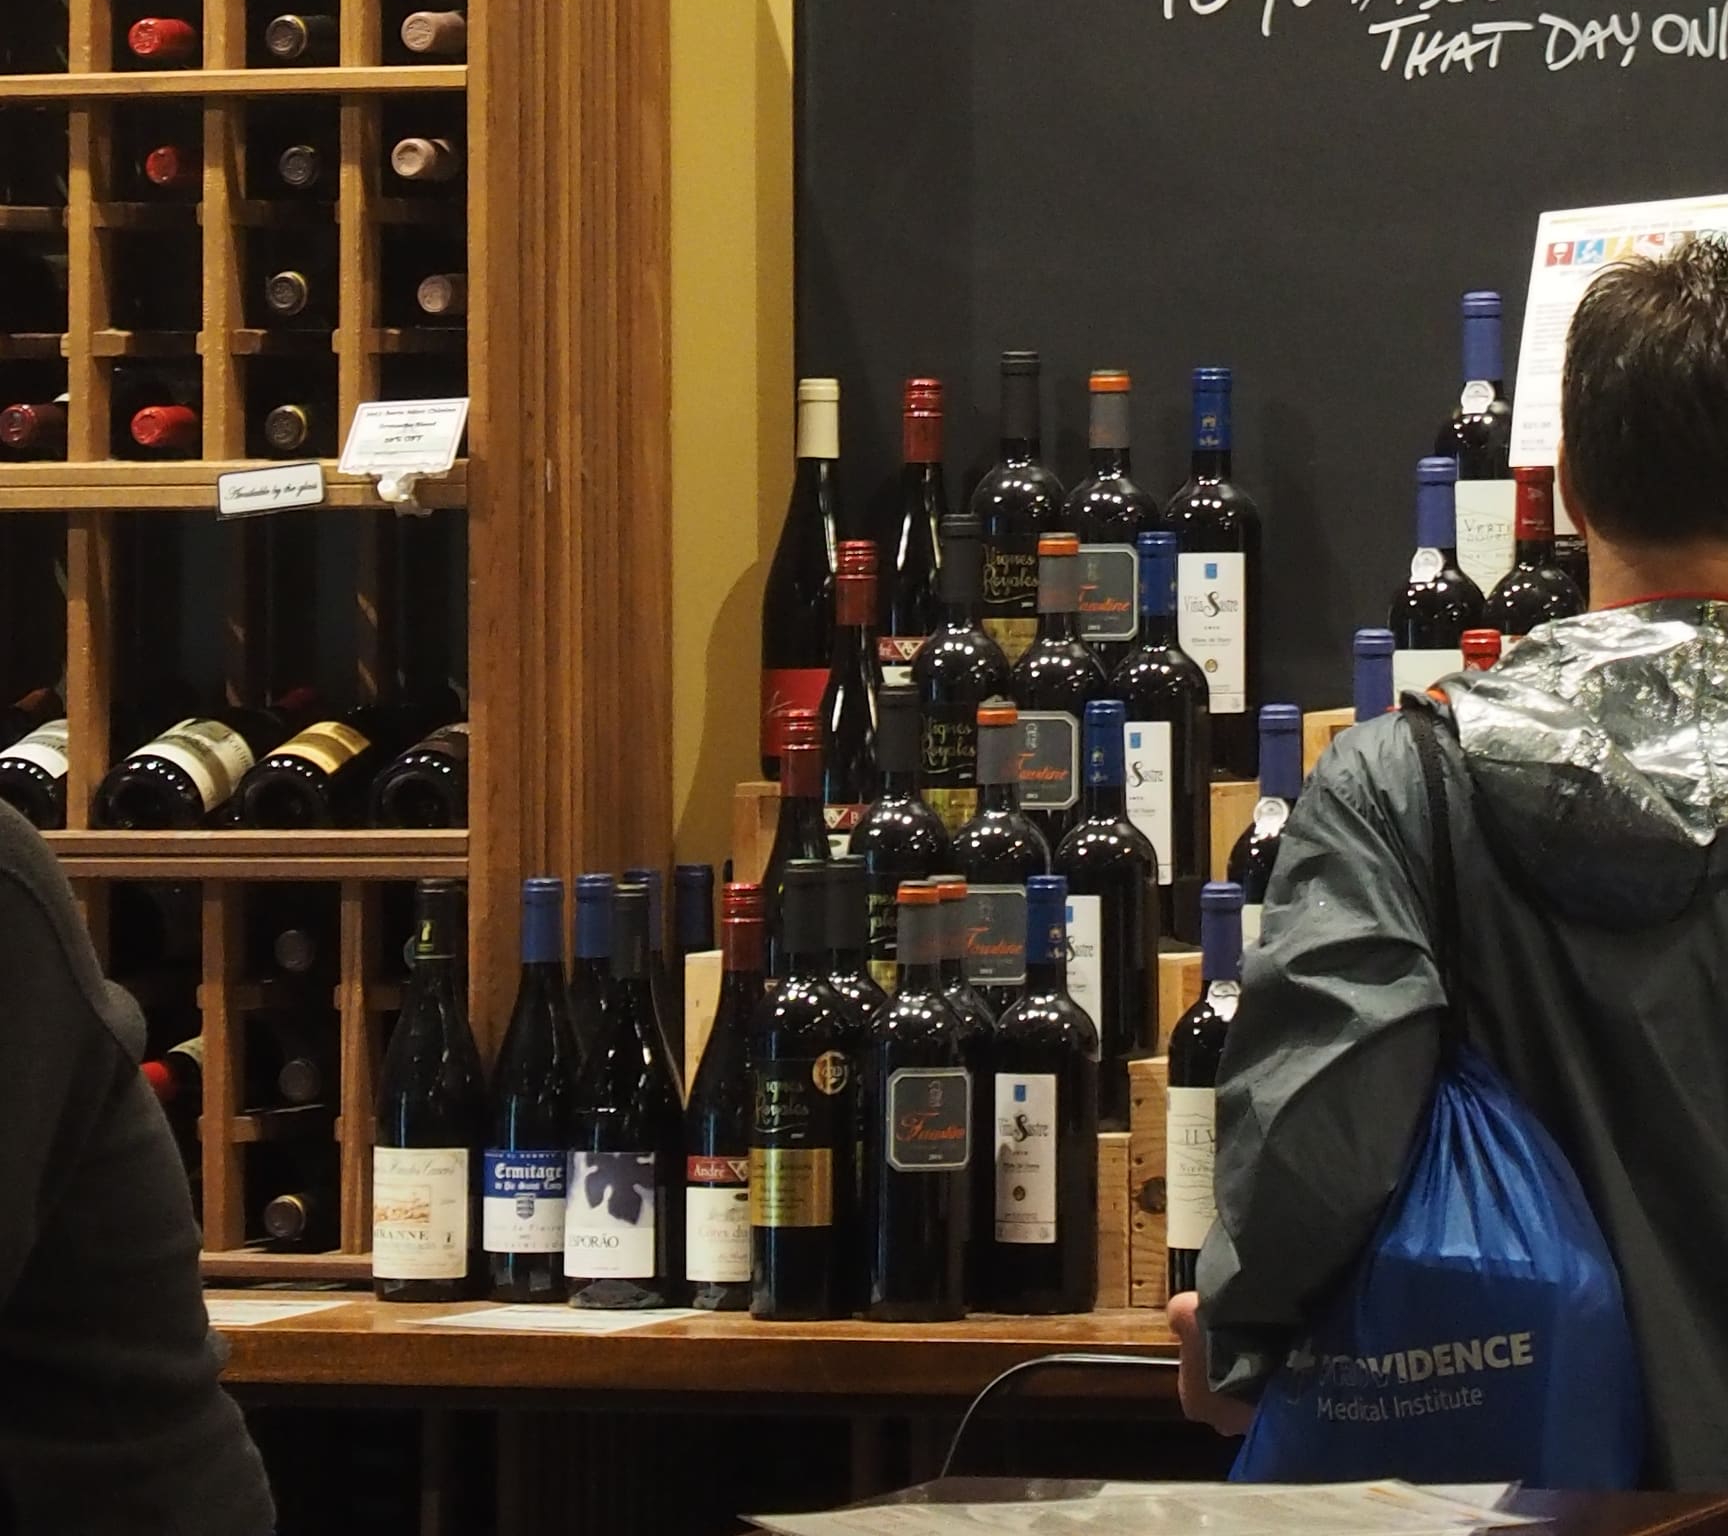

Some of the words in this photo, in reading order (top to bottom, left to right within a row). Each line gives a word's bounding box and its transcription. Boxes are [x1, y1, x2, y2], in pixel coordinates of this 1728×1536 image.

[1368, 13, 1534, 80] THAT
[1539, 12, 1642, 70] DAY
[494, 1161, 564, 1181] Ermitage
[1394, 1385, 1484, 1419] Institute
